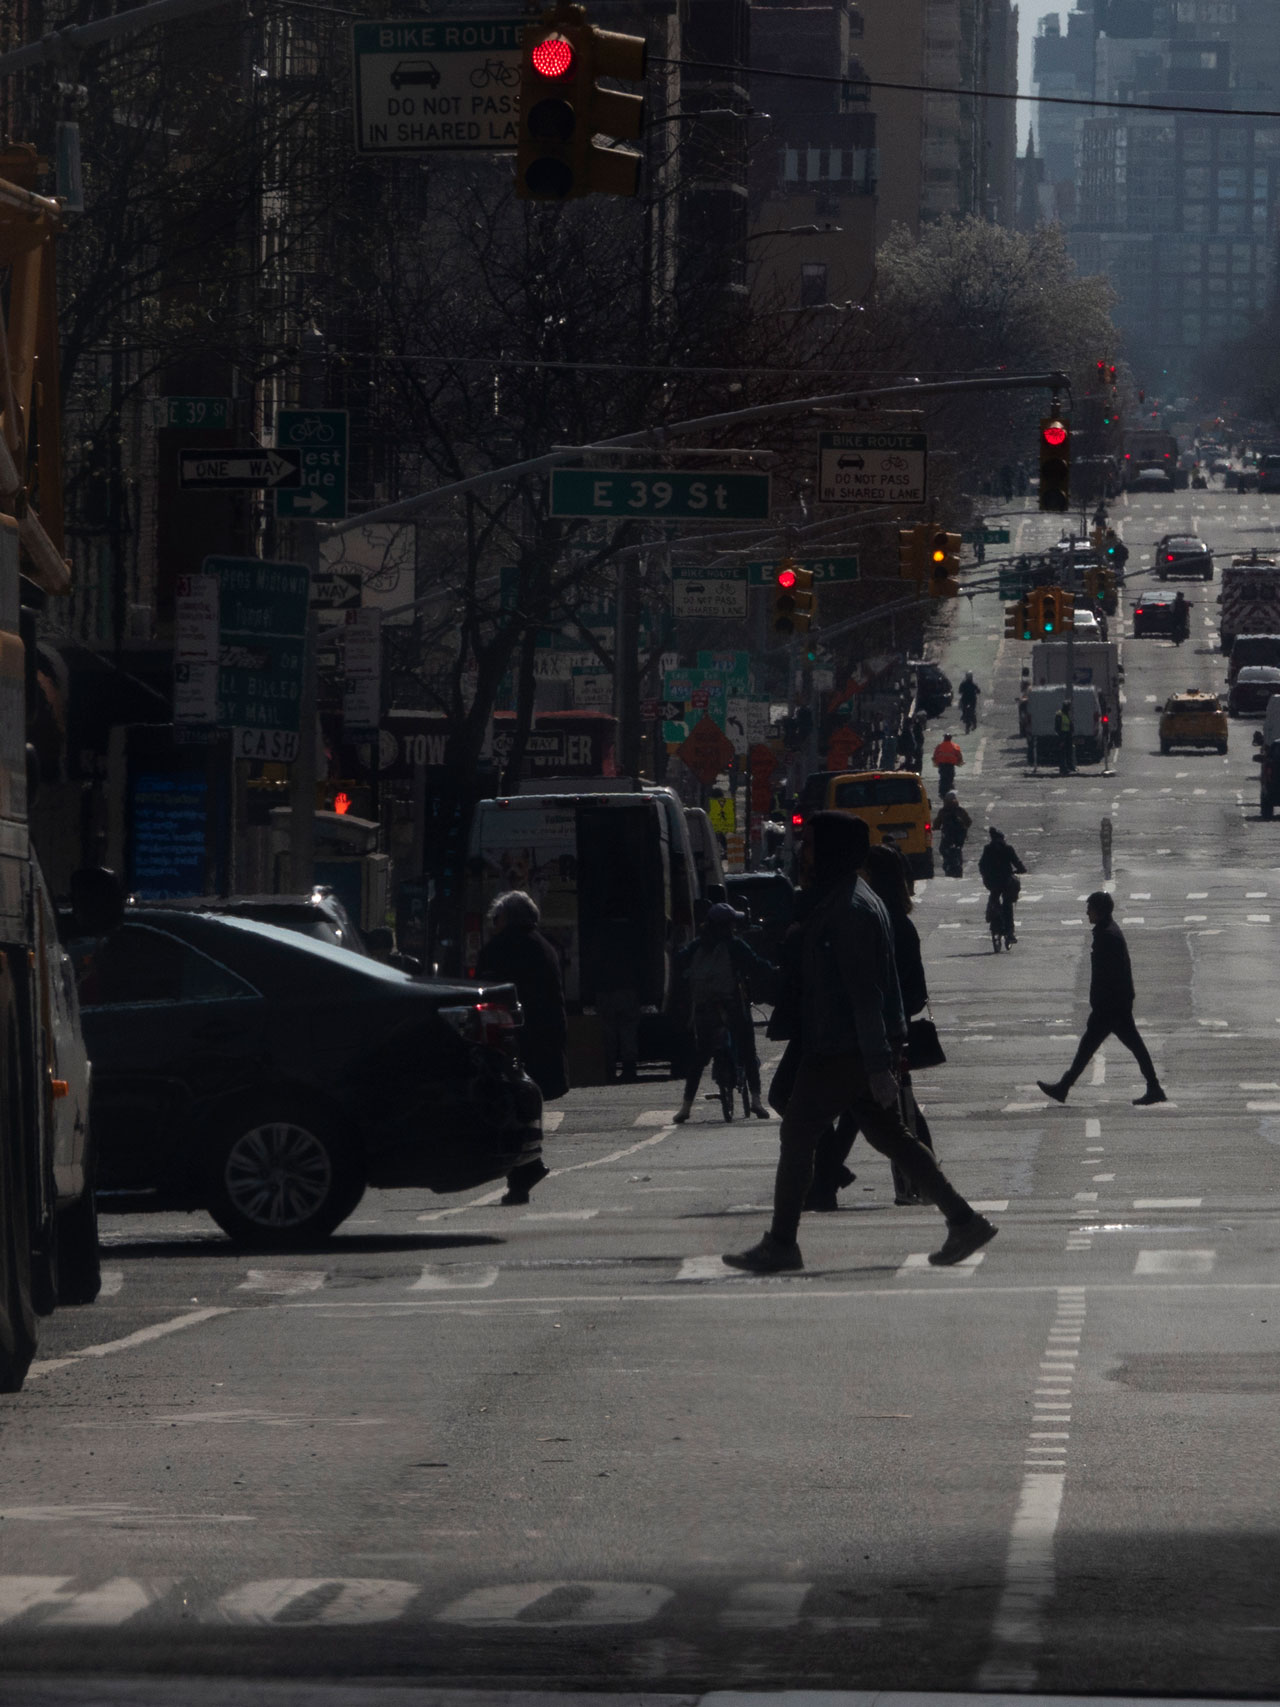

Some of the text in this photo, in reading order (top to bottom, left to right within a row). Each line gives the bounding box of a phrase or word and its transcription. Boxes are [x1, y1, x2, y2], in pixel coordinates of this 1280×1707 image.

[379, 25, 524, 48] BIKE ROUTE
[388, 98, 415, 116] DO
[423, 97, 461, 115] NOT
[370, 121, 519, 142] IN SHARED LA
[169, 402, 179, 423] E
[186, 401, 206, 424] 39
[832, 435, 912, 448] BIKE ROUTE
[305, 450, 342, 466] est
[195, 461, 284, 478] ONE WAY
[301, 469, 336, 486] ide
[835, 474, 910, 485] DO NOT PASS
[593, 481, 728, 510] E 39 St
[824, 488, 920, 500] IN SHARED LANE
[681, 568, 704, 578] BIKE
[761, 564, 774, 581] E
[813, 562, 835, 578] St
[317, 584, 349, 598] WAY
[242, 730, 297, 759] CASH
[403, 735, 449, 766] TOW
